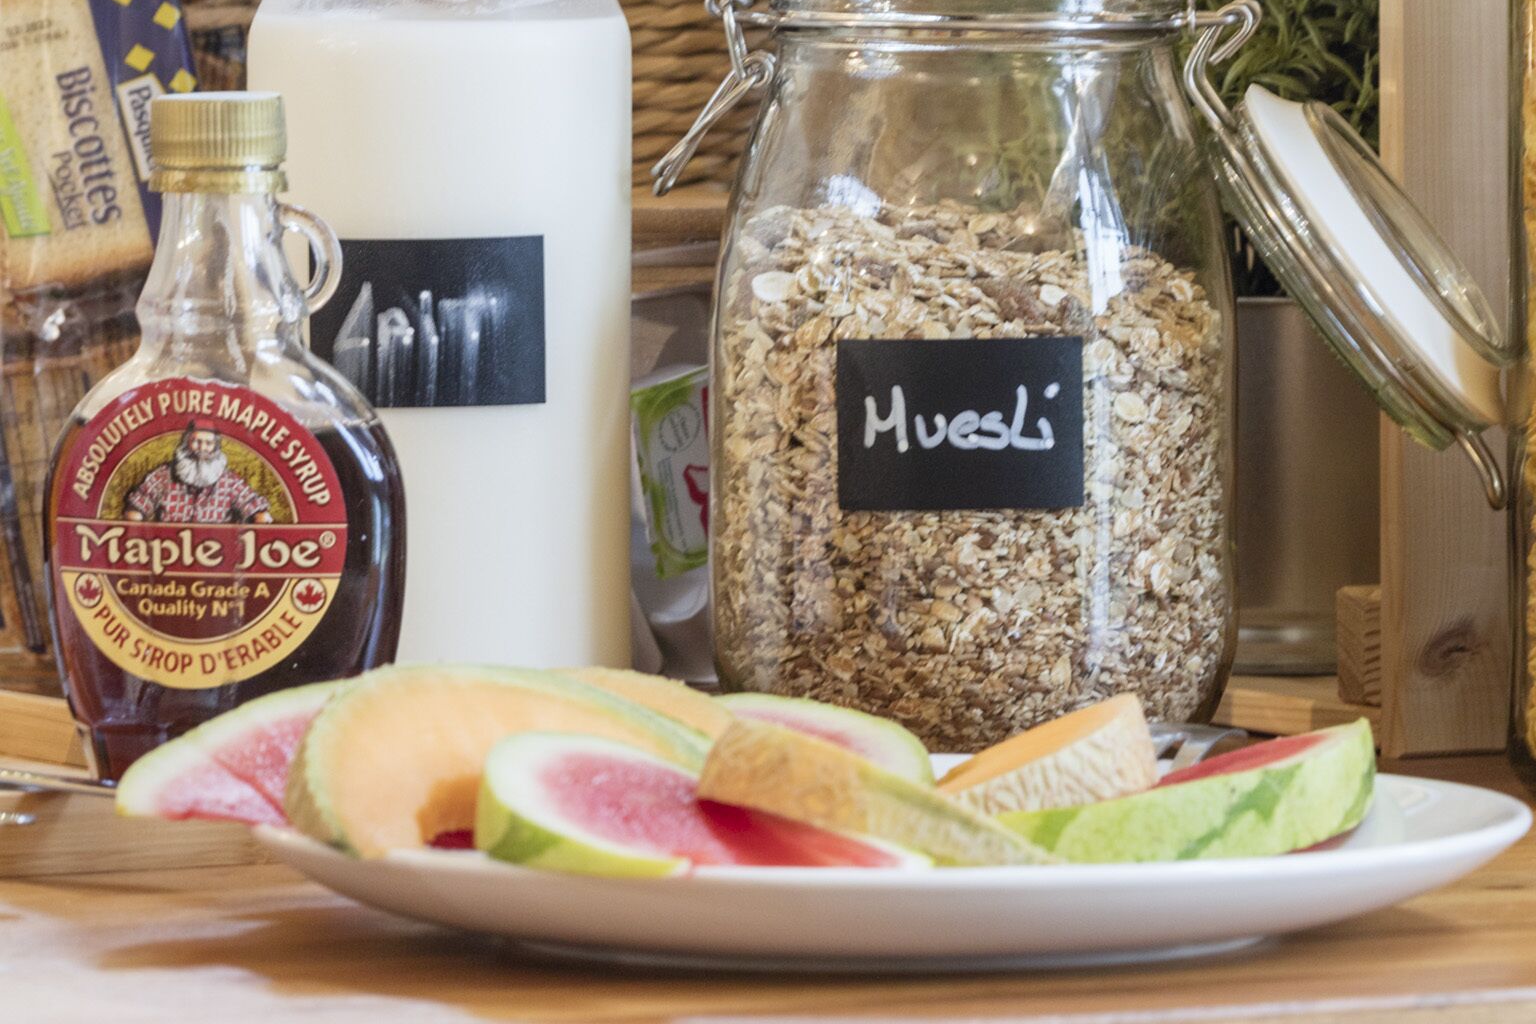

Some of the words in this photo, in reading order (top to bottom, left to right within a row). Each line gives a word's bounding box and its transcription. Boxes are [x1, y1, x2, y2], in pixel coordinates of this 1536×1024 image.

[56, 65, 122, 226] Biscottes
[51, 150, 89, 230] Pocket
[71, 396, 154, 501] ABSOLUTELY
[158, 389, 213, 416] PURE
[217, 395, 286, 449] MAPLE
[280, 439, 332, 507] SYRUP
[75, 524, 223, 576] Maple
[116, 578, 186, 598] Canada
[191, 578, 250, 598] Grade
[254, 583, 270, 598] A
[138, 598, 206, 620] Quality
[93, 605, 129, 650] PUR
[129, 639, 193, 675] SIROP
[200, 611, 302, 676] D'ERABLE
